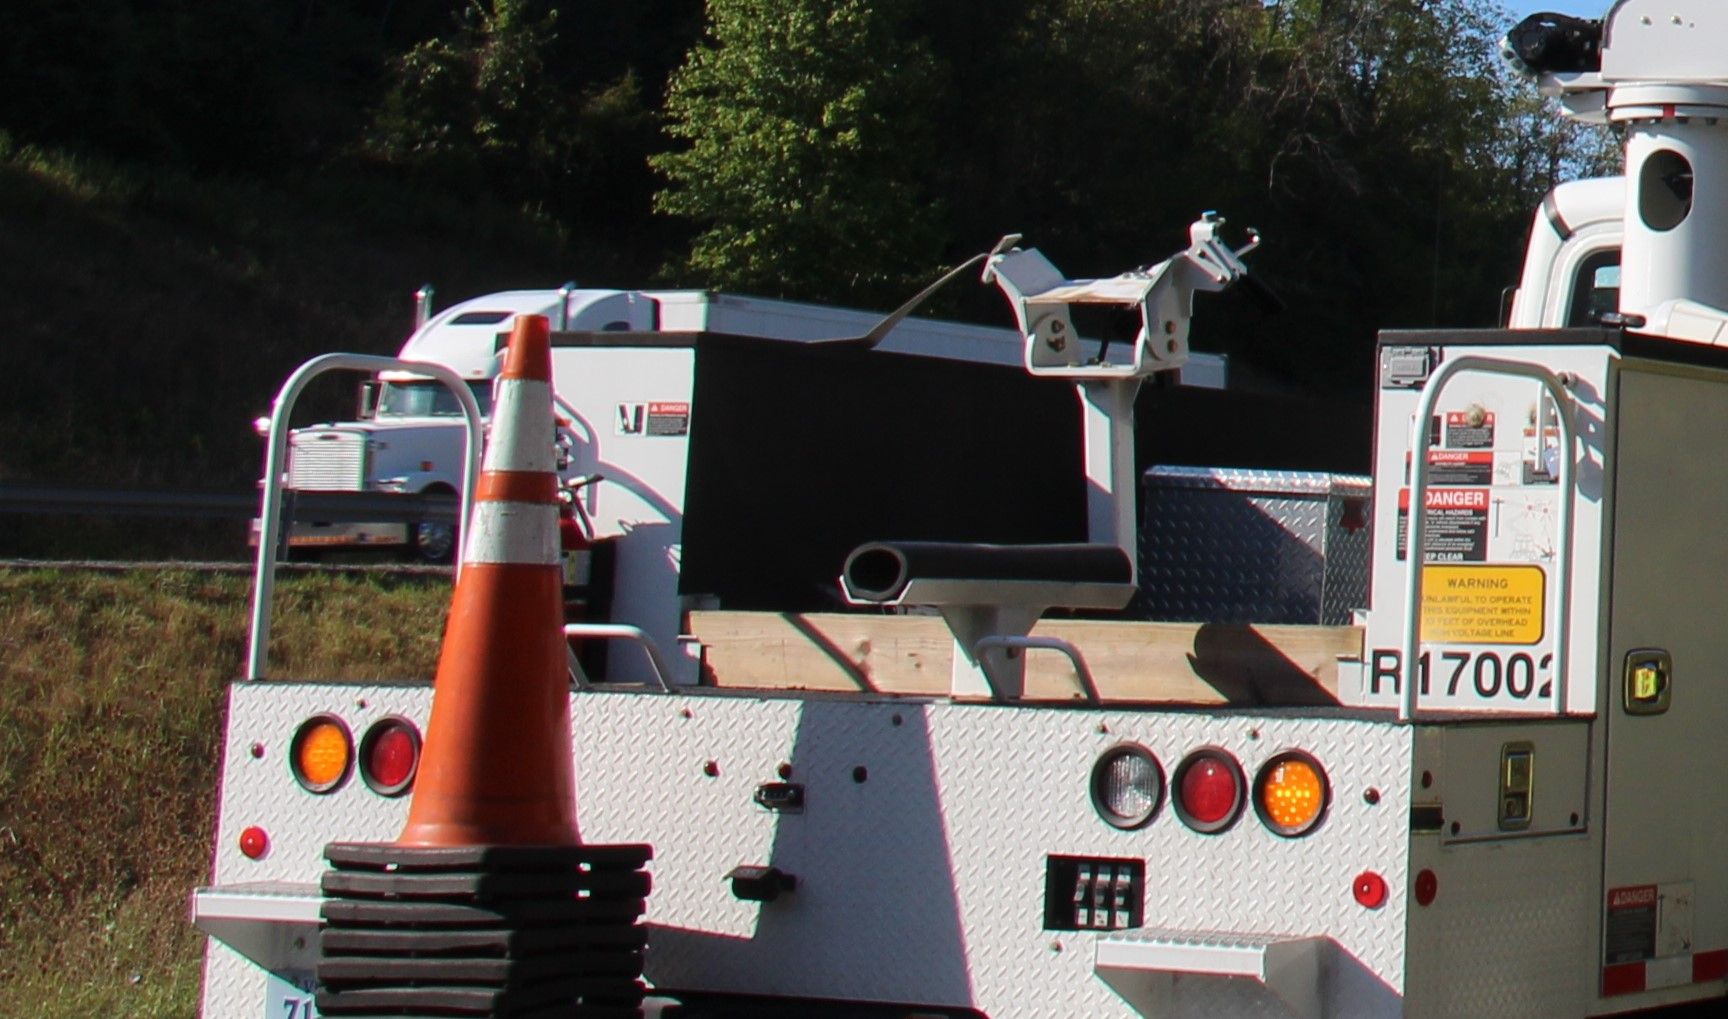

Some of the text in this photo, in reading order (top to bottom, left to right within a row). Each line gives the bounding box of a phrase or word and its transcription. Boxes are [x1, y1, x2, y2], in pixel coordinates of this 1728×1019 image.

[1439, 452, 1469, 461] DANGER
[1437, 552, 1464, 561] CLEAR
[1447, 578, 1508, 589] WARNING
[1475, 596, 1487, 604] TO
[1489, 596, 1532, 604] OPERATE
[1445, 606, 1498, 615] EQUIPMENT
[1500, 607, 1531, 615] WITHIN
[1462, 618, 1475, 626] OF
[1476, 618, 1528, 627] OVERHEAD
[1495, 629, 1515, 638] LINE
